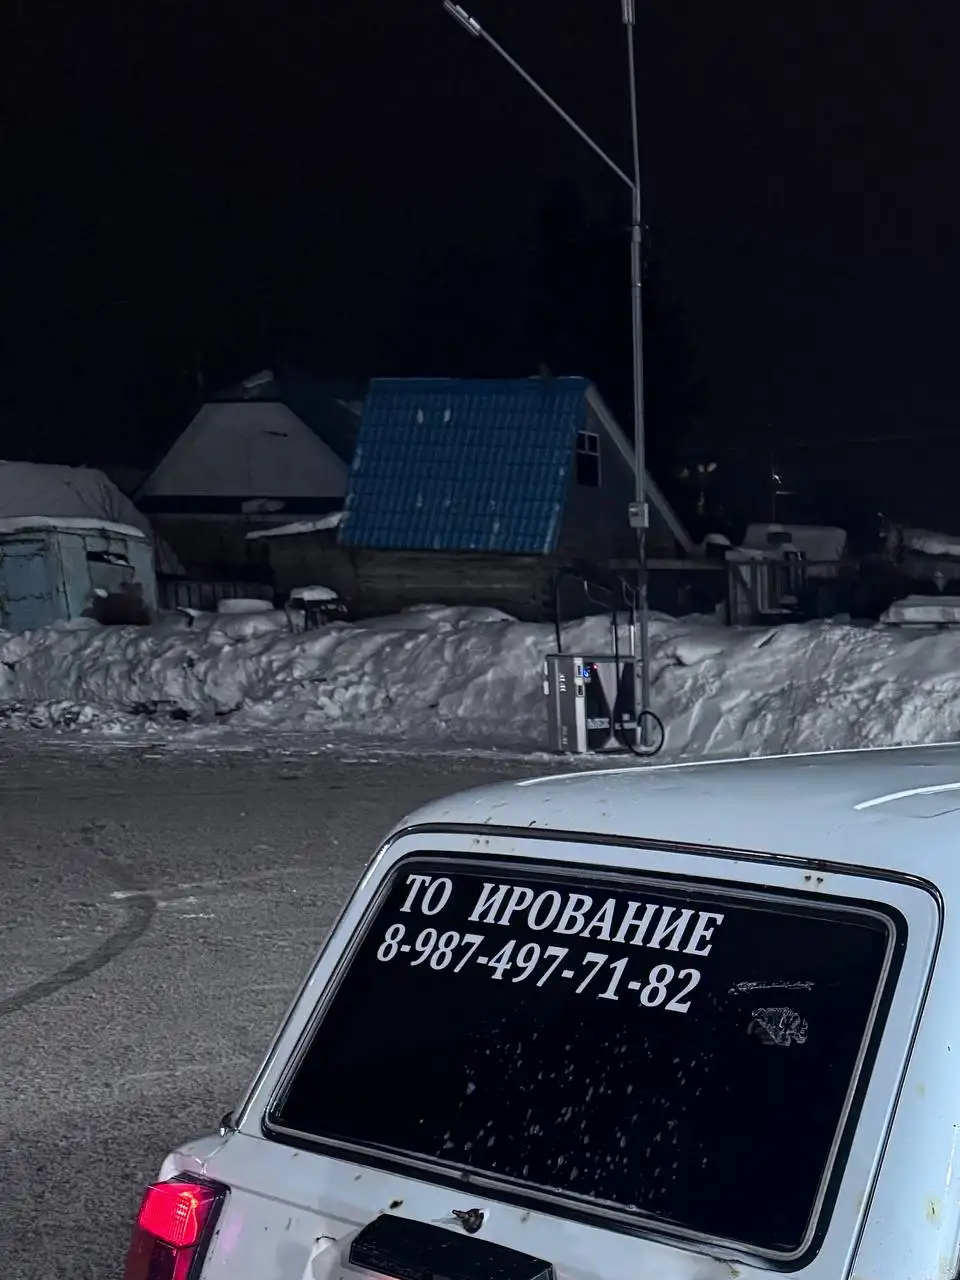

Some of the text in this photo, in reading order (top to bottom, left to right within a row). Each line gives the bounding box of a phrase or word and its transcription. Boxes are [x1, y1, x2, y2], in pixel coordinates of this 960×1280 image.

[399, 874, 724, 957] ТО ИРОВАНИЕ
[377, 924, 701, 1013] 8-987-497-71-82
